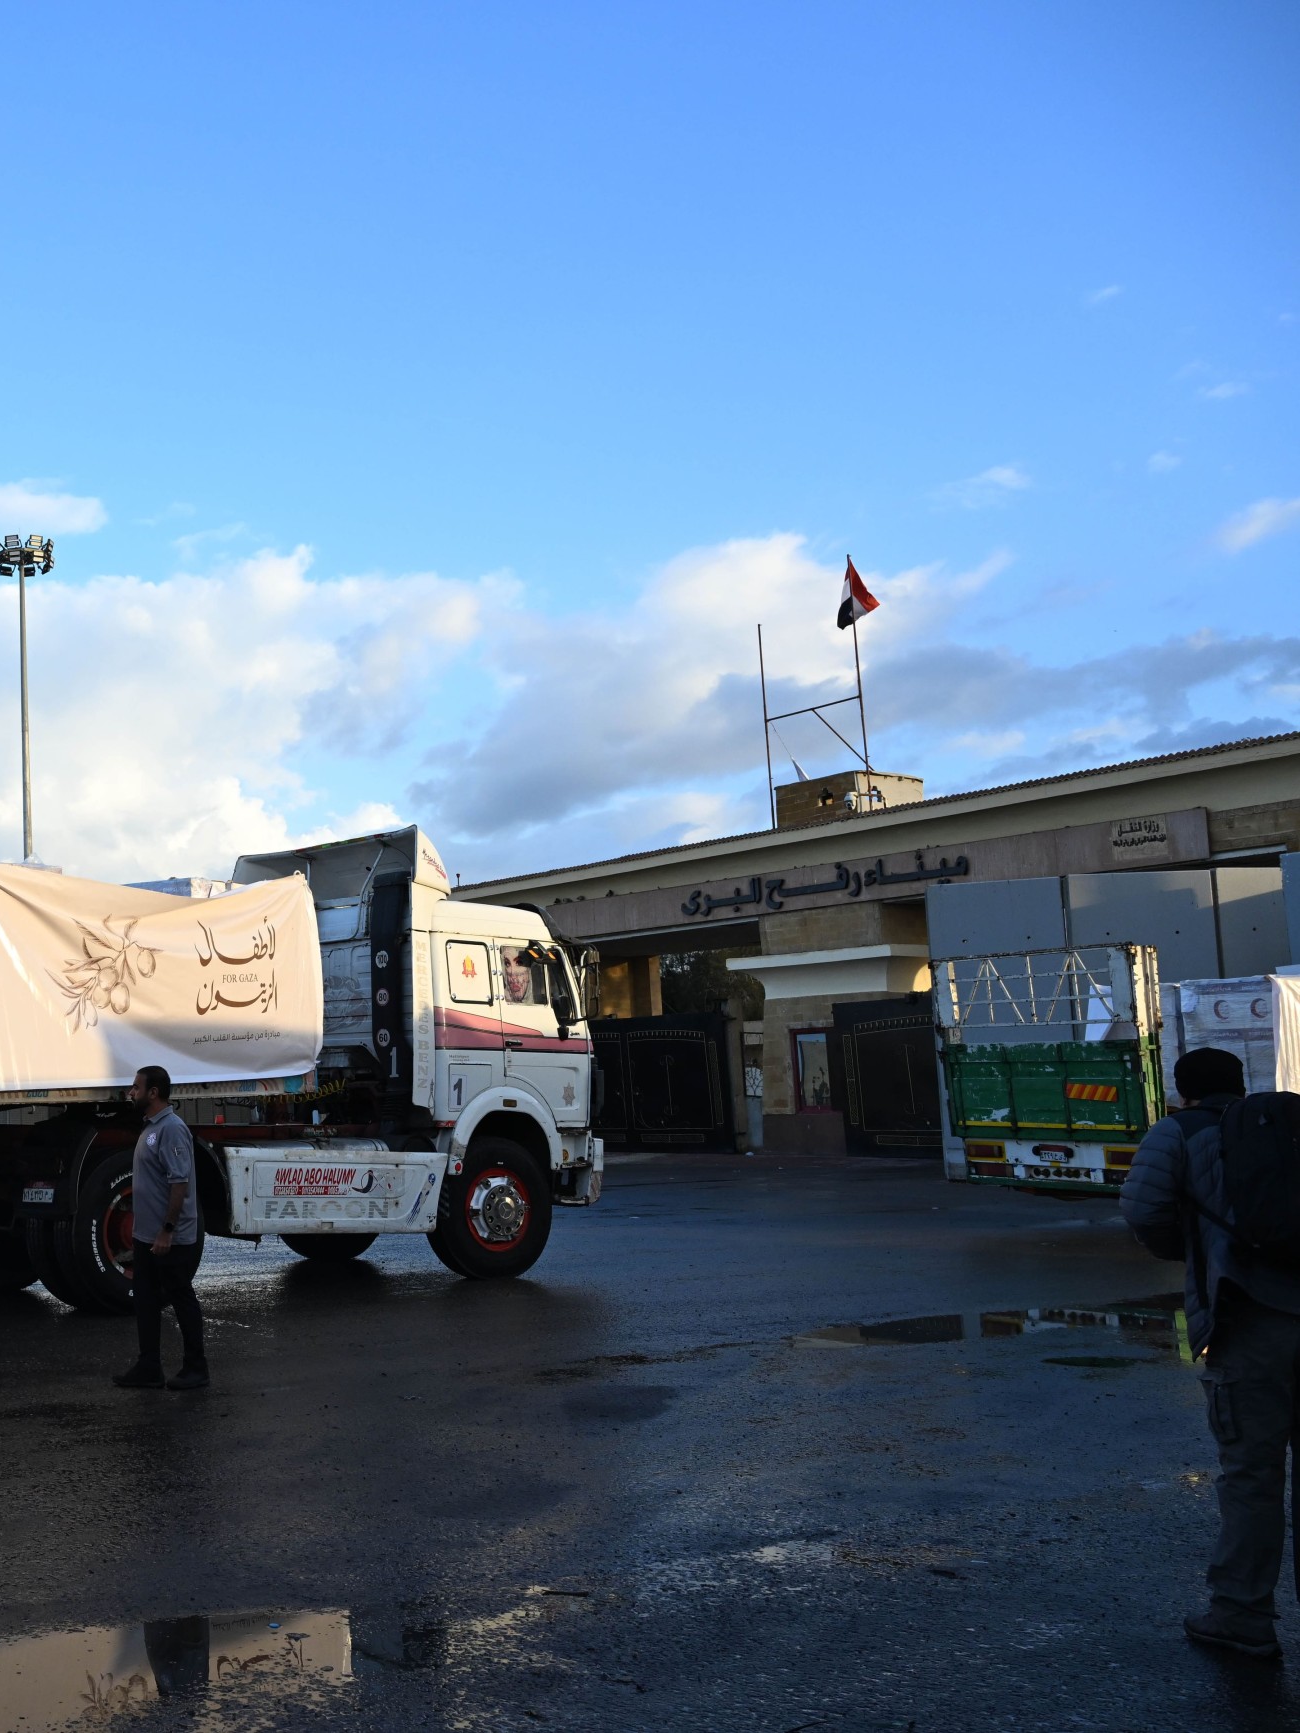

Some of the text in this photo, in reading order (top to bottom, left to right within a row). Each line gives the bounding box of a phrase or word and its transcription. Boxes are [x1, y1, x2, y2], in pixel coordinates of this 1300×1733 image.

[863, 850, 969, 889] ميناء
[764, 862, 862, 909] رفح
[222, 973, 259, 983] FOR GAZA
[377, 992, 388, 1003] 80
[192, 1034, 212, 1045] الكبير
[212, 1034, 231, 1043] القلب
[231, 1031, 254, 1041] مؤسسة
[254, 1032, 264, 1040] من
[379, 1032, 389, 1043] 60
[389, 1046, 400, 1079] 1
[416, 1041, 430, 1089] BENZ
[453, 1077, 464, 1107] 1
[303, 1168, 322, 1185] ABO
